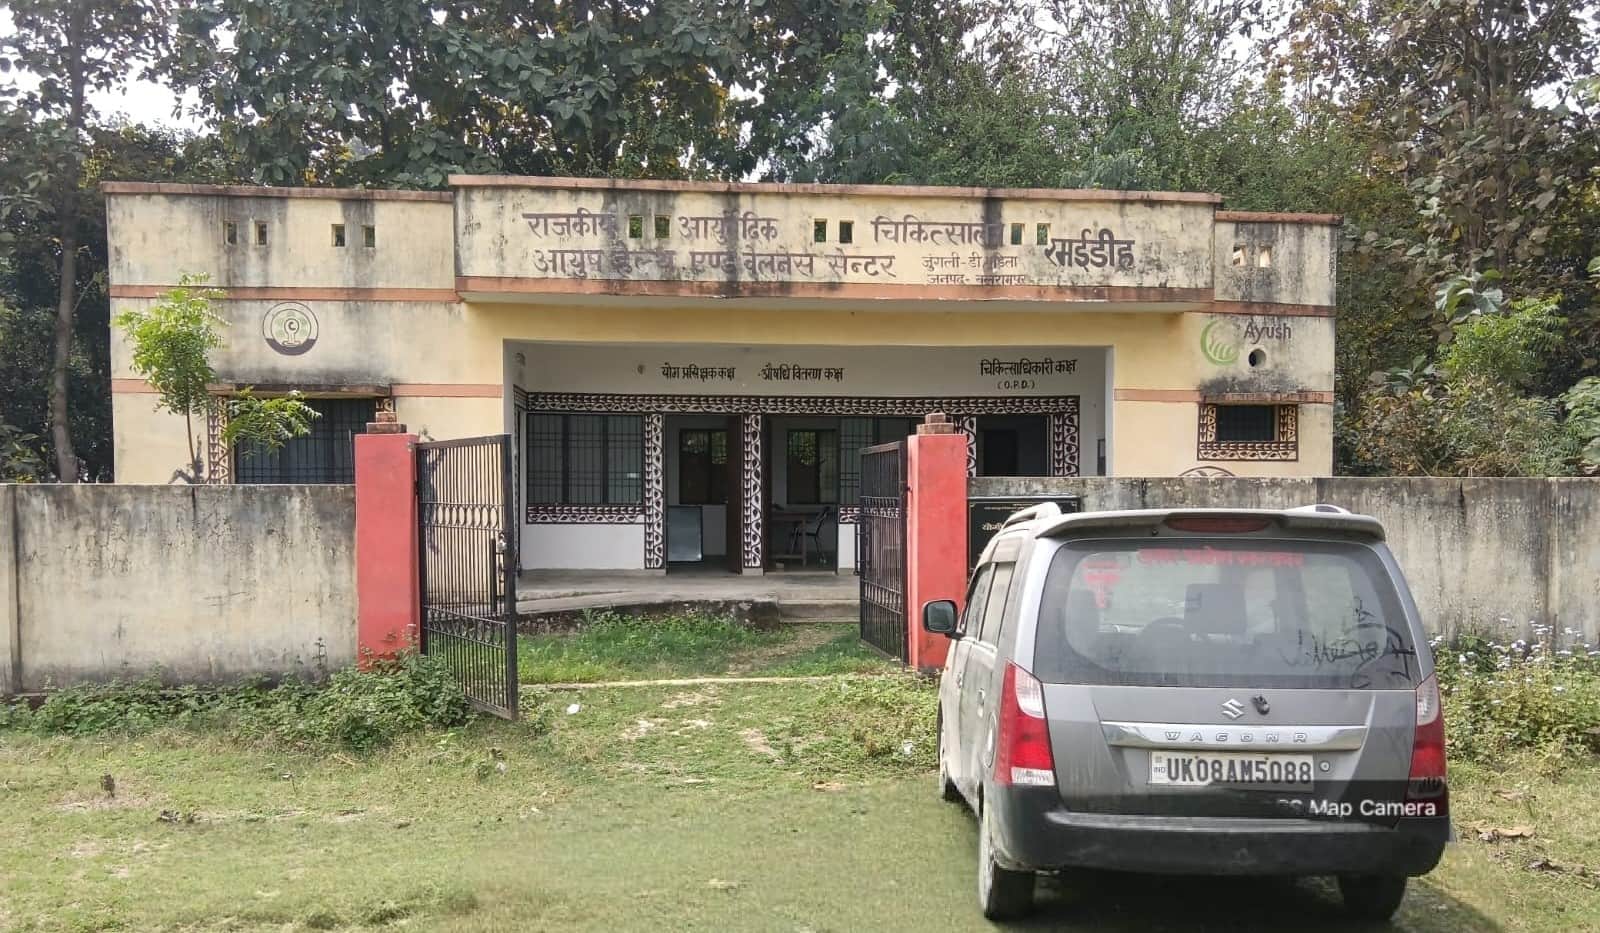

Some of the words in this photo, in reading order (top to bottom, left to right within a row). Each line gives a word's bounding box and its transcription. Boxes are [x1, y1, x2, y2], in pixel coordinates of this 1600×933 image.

[533, 250, 604, 277] आयुष
[824, 247, 896, 278] सेन्टर
[1243, 321, 1292, 345] Ayush
[660, 361, 680, 379] योग
[792, 363, 823, 381] वितरण
[824, 367, 846, 382] कक्ष
[980, 357, 1054, 377] चिकित्साधिकारी
[1055, 358, 1078, 375] कक्ष
[1167, 757, 1312, 784] UK08AM5088
